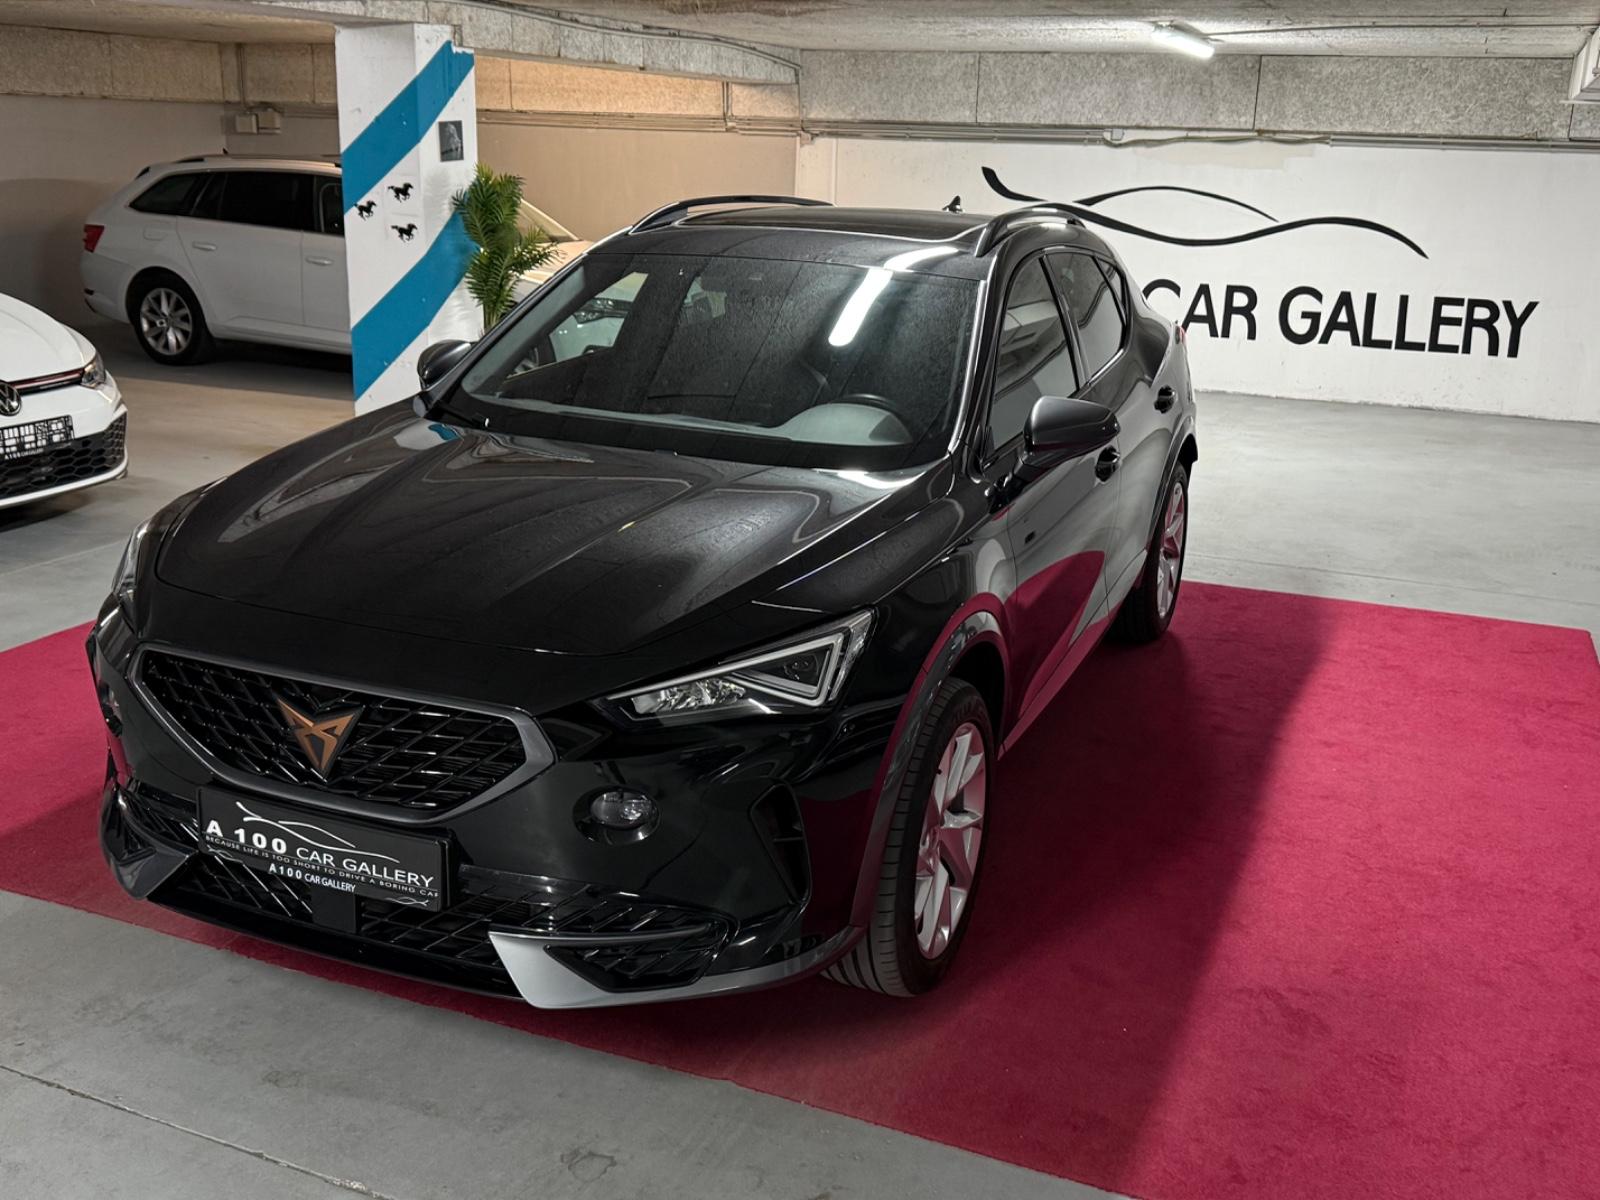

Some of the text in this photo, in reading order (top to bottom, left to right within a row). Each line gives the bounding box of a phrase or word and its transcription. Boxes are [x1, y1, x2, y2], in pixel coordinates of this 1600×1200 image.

[1278, 285, 1540, 358] GALLERY
[205, 834, 240, 851] BECAUSE
[243, 846, 259, 857] LIFE
[272, 854, 290, 864] TOO
[293, 859, 320, 872] SHORT
[324, 867, 336, 875] TO
[339, 871, 365, 882] DRIVE
[380, 880, 416, 893] BORING
[206, 819, 434, 888] A 100 CAR GALLERY
